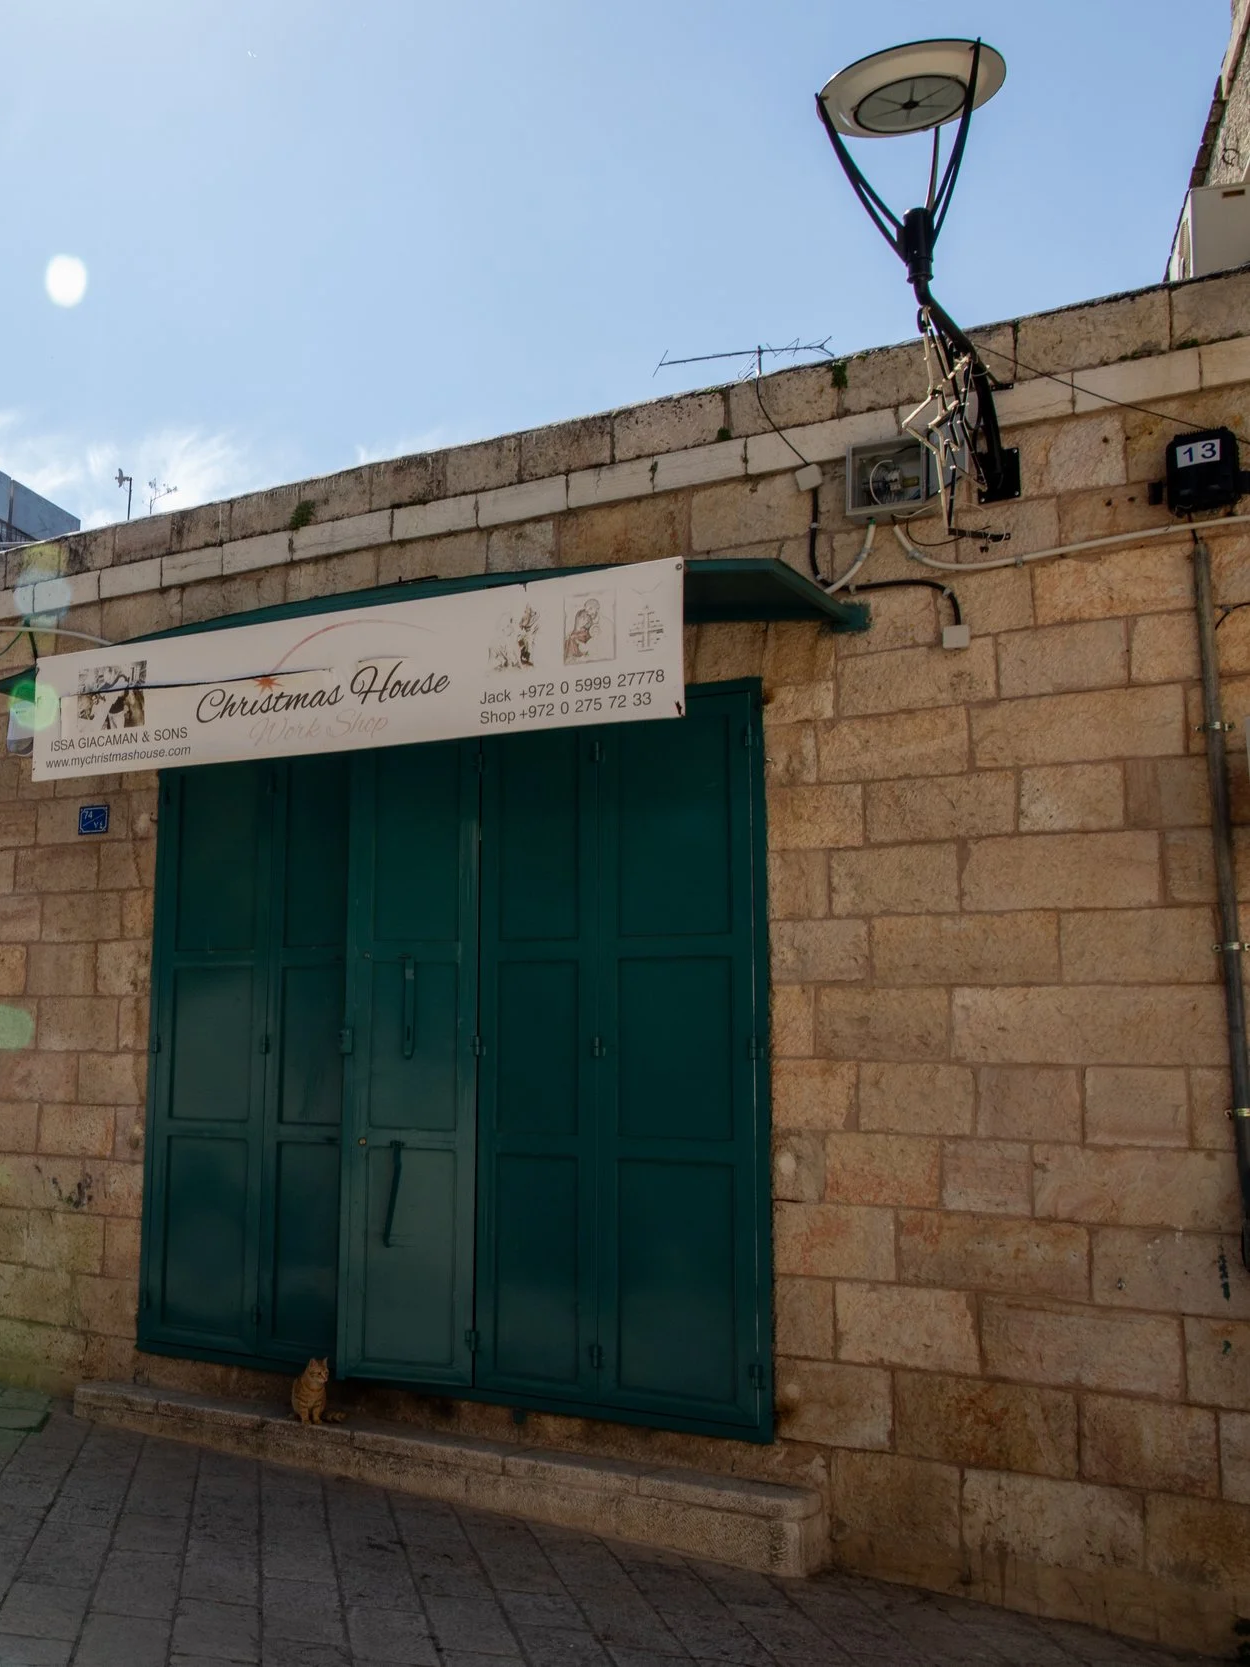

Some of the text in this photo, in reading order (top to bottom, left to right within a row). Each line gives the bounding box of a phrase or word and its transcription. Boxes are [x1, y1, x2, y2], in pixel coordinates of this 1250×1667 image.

[1182, 442, 1217, 463] 13
[195, 660, 451, 724] Christmas House
[479, 669, 665, 705] Jack +972 0 5999 27778
[479, 691, 652, 724] Shop +972 0 275 72 33
[50, 726, 188, 752] ISSA GIACAMAN & SONS
[46, 745, 191, 769] www.mychristmashouse.com
[84, 810, 93, 820] 74
